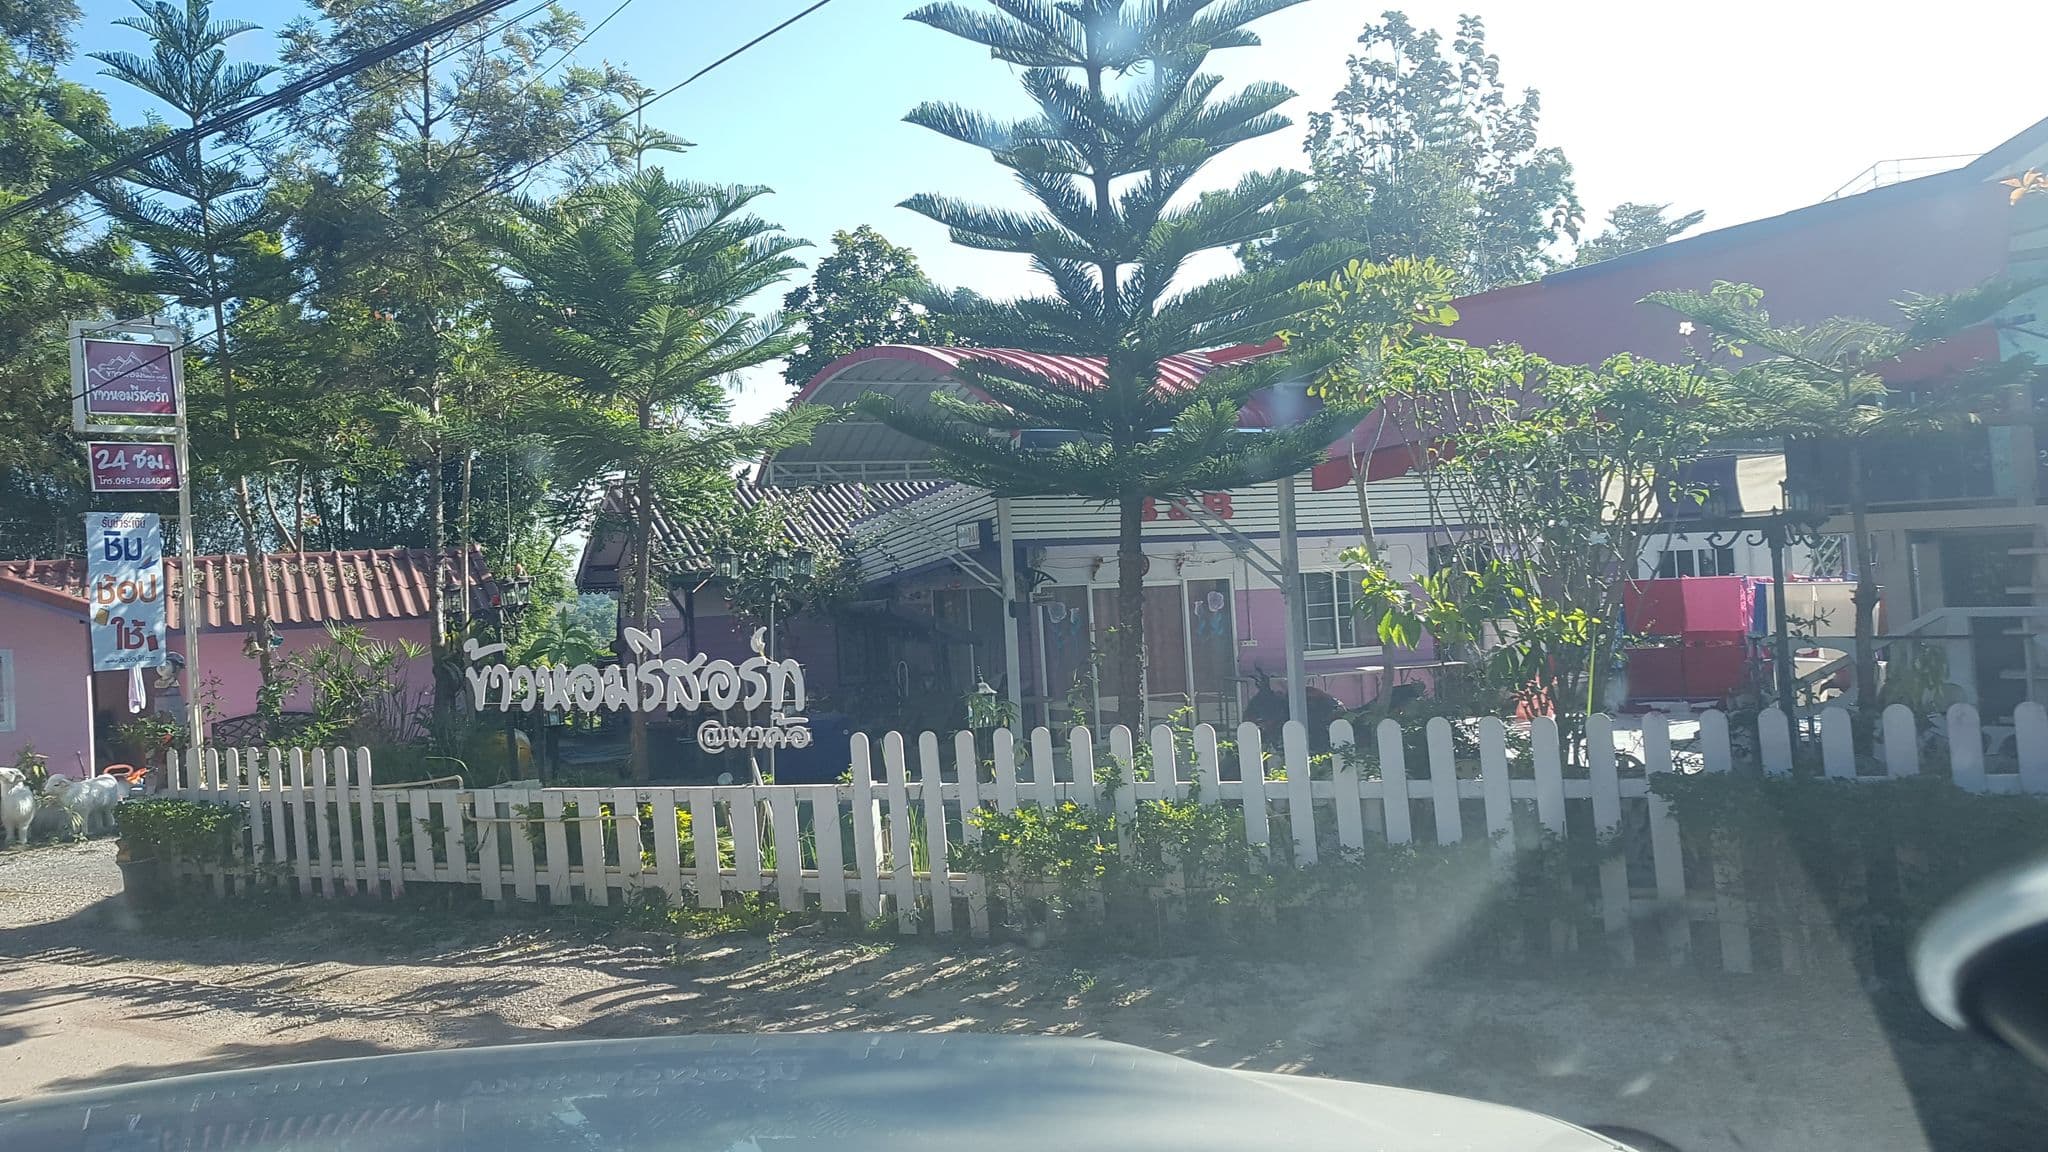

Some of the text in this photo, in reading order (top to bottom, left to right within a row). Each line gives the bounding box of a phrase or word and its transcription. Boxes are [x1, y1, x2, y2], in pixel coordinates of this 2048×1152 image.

[95, 449, 170, 470] 24 ชม.
[103, 531, 142, 561] ชิม
[96, 574, 157, 604] ช้อป
[110, 616, 146, 650] ใช้
[463, 627, 805, 712] ข้าวหอมรีสอร์ท
